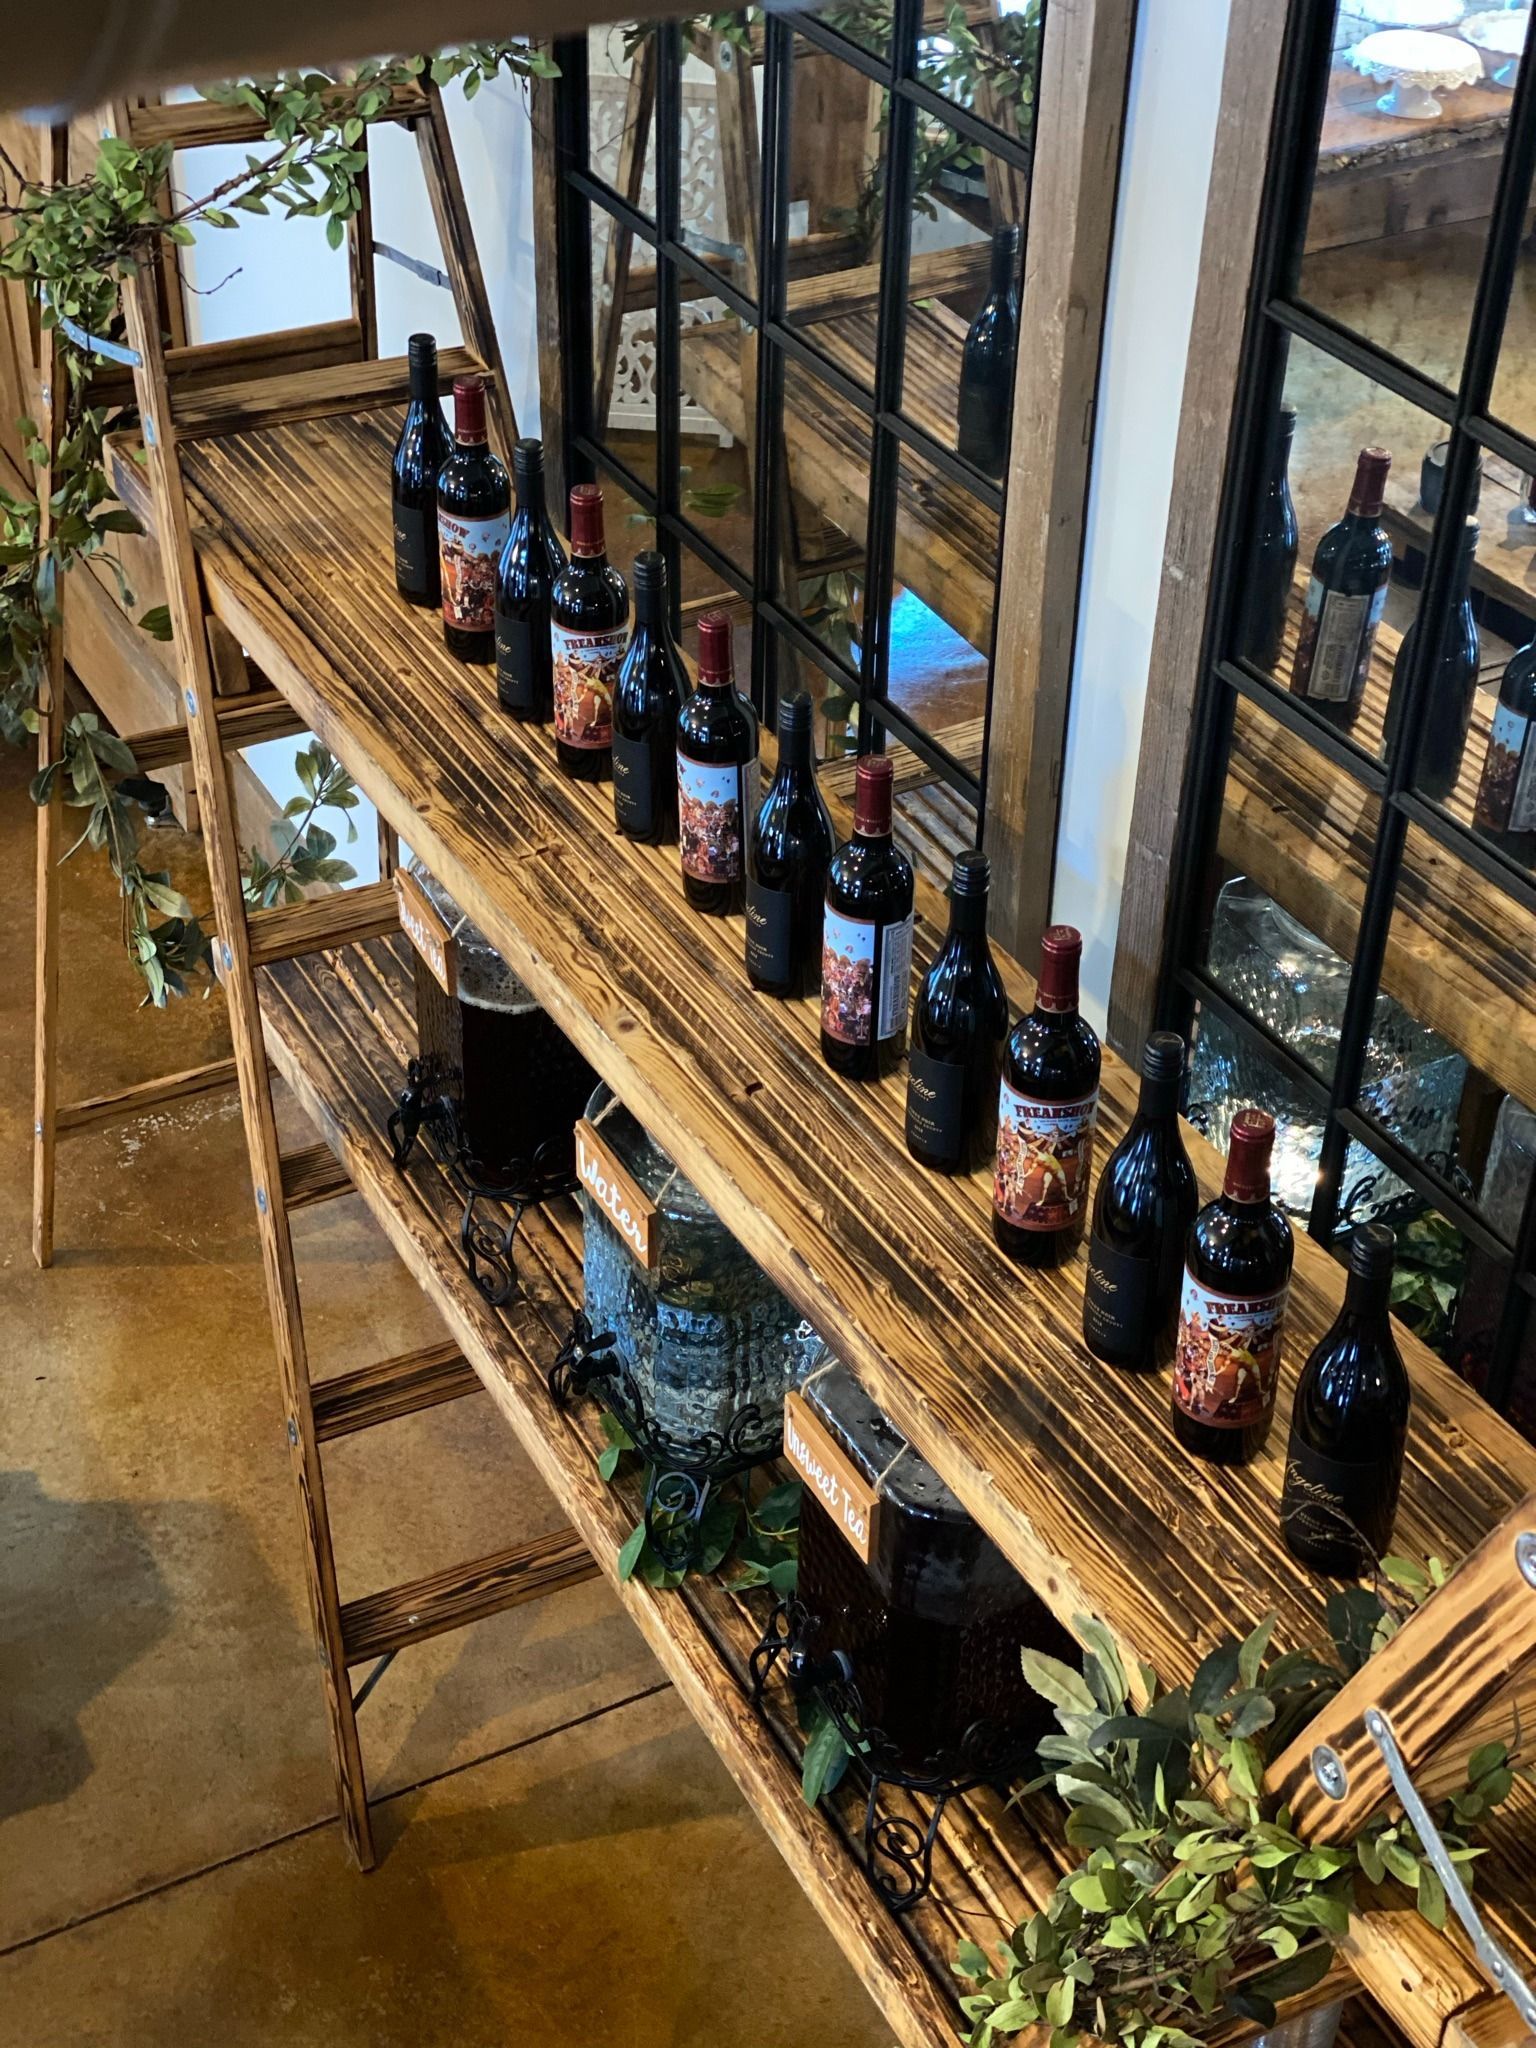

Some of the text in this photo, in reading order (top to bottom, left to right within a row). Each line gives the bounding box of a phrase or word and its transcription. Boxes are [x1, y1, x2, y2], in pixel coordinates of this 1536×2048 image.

[579, 1140, 647, 1253] Water
[787, 1416, 867, 1545] Unsweet Tea
[1286, 1458, 1344, 1504] Angeline
